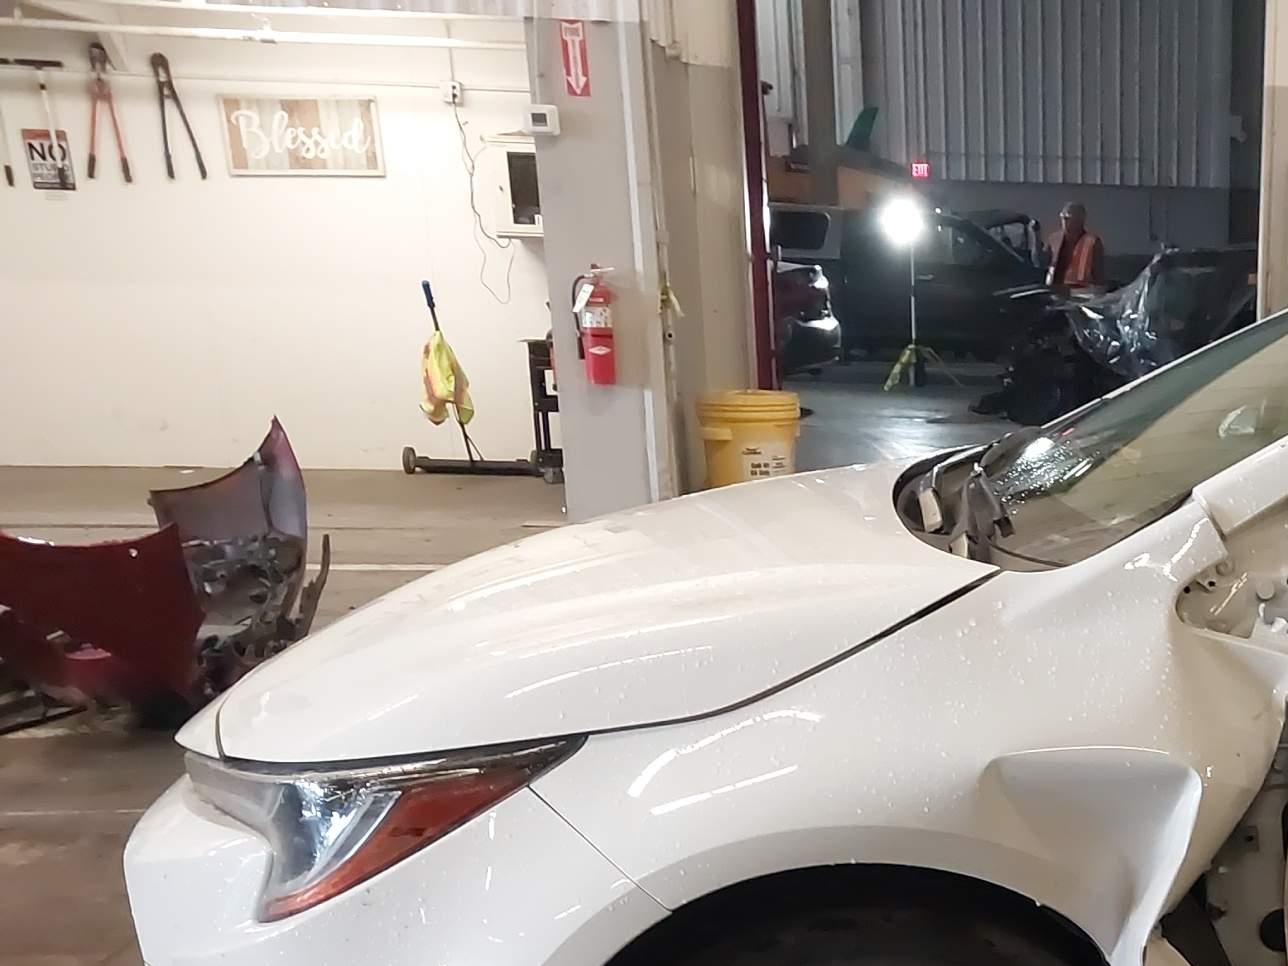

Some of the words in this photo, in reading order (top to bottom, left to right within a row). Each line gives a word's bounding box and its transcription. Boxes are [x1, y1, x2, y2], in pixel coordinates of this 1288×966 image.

[230, 109, 371, 159] Blessed
[27, 142, 67, 161] NO
[911, 163, 929, 177] EXIT
